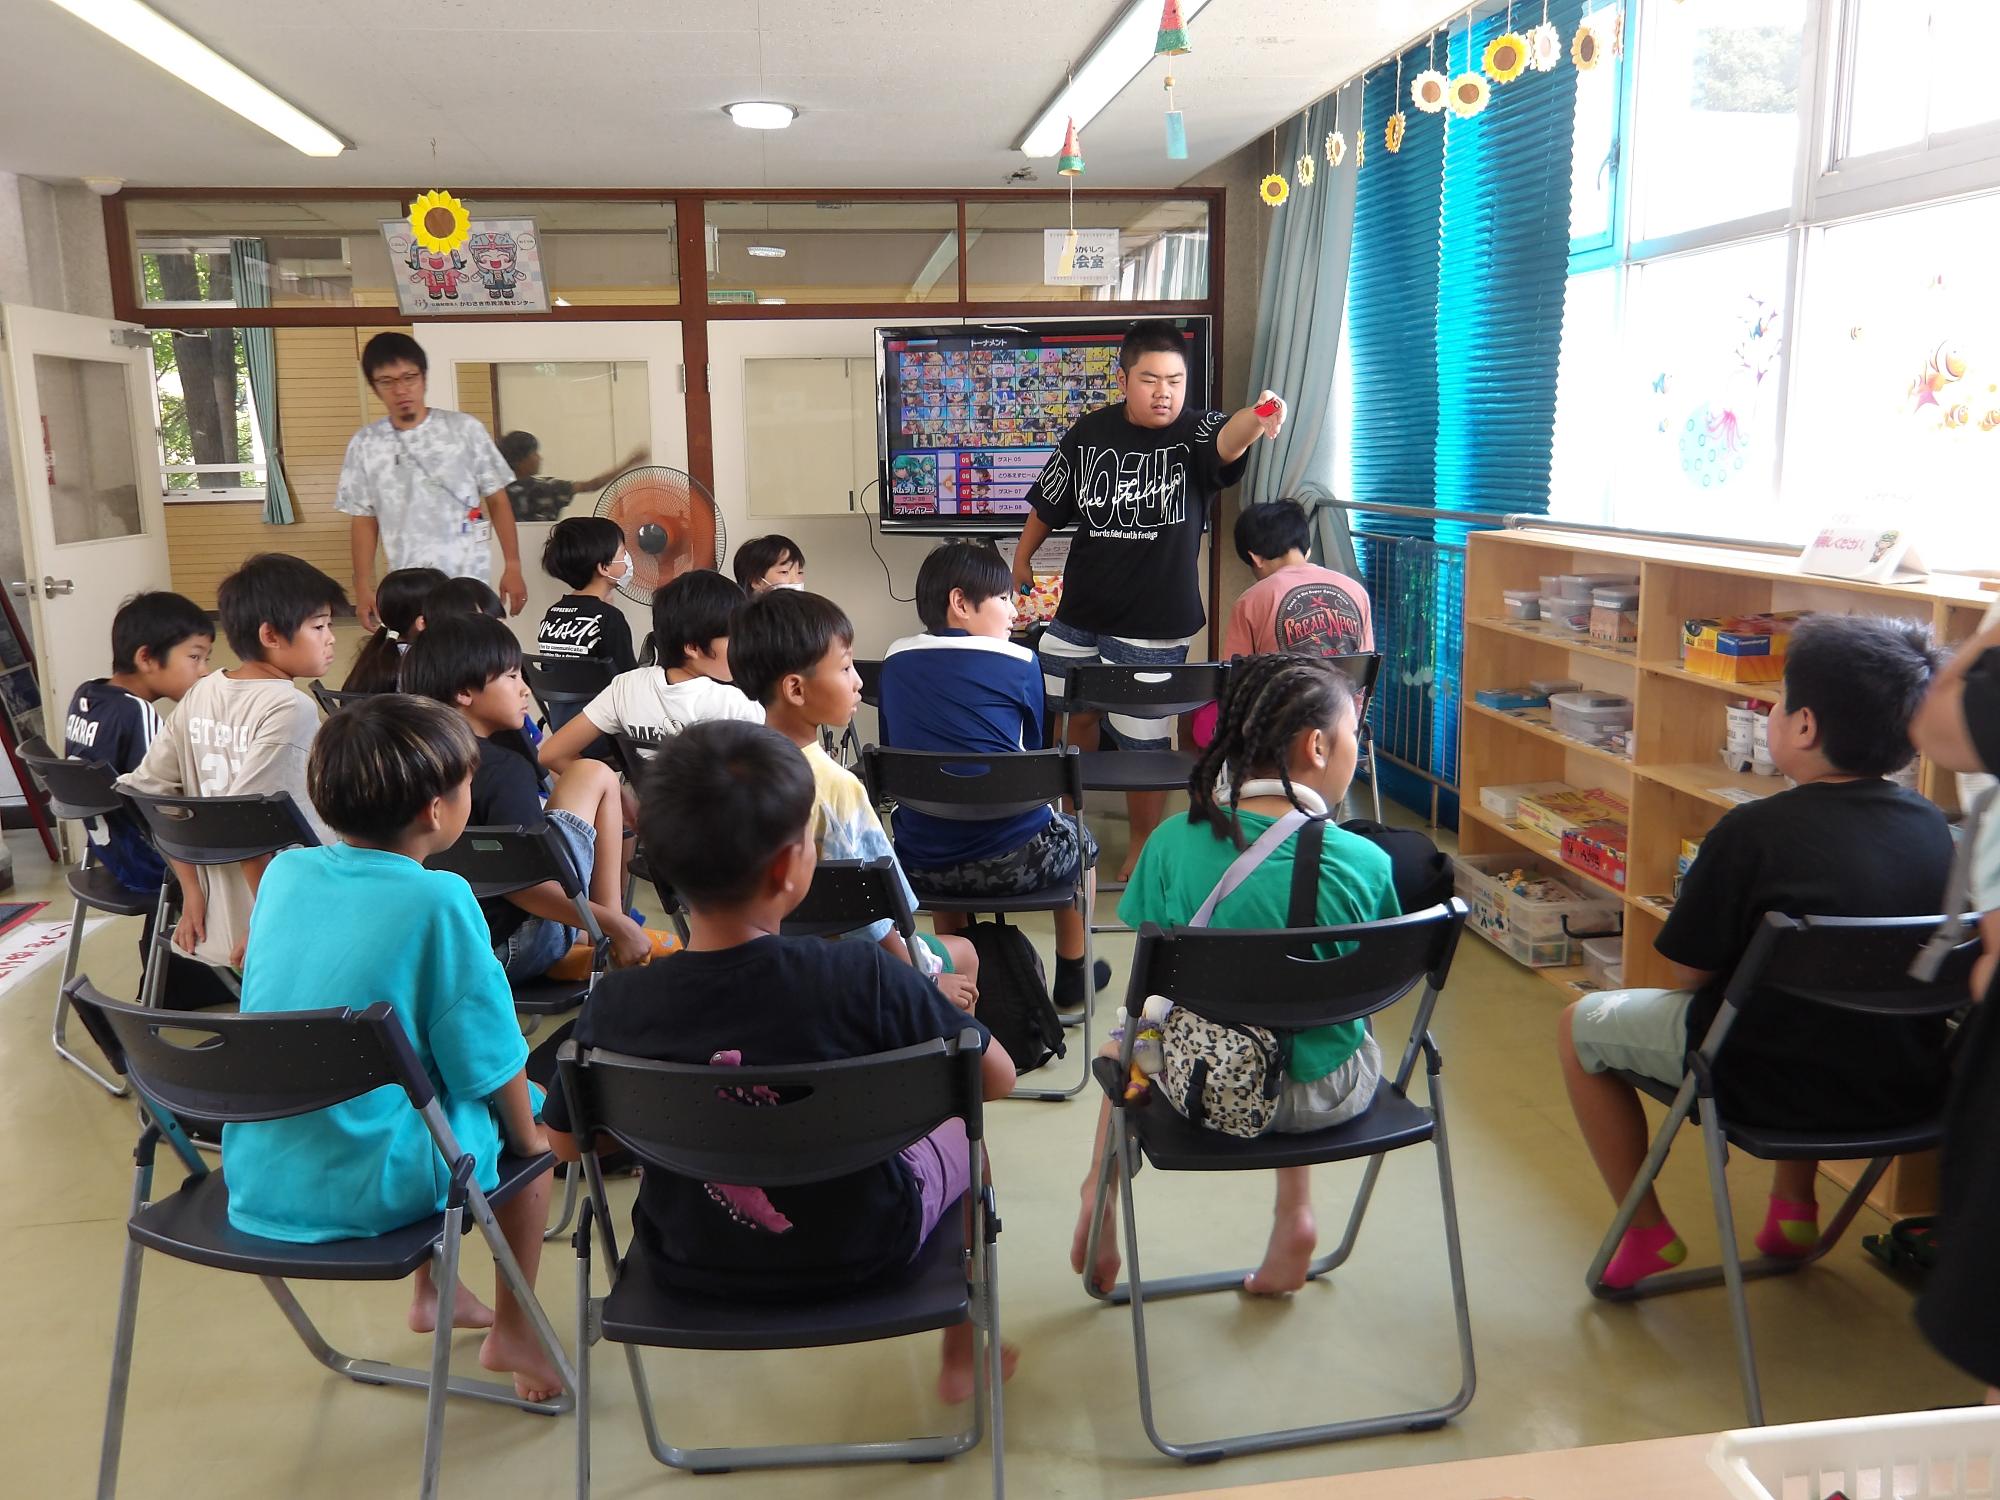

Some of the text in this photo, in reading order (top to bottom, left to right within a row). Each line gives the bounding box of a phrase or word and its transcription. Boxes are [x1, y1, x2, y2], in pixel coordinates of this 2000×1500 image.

[1072, 255, 1104, 269] 会室
[971, 339, 1007, 347] トーナメント
